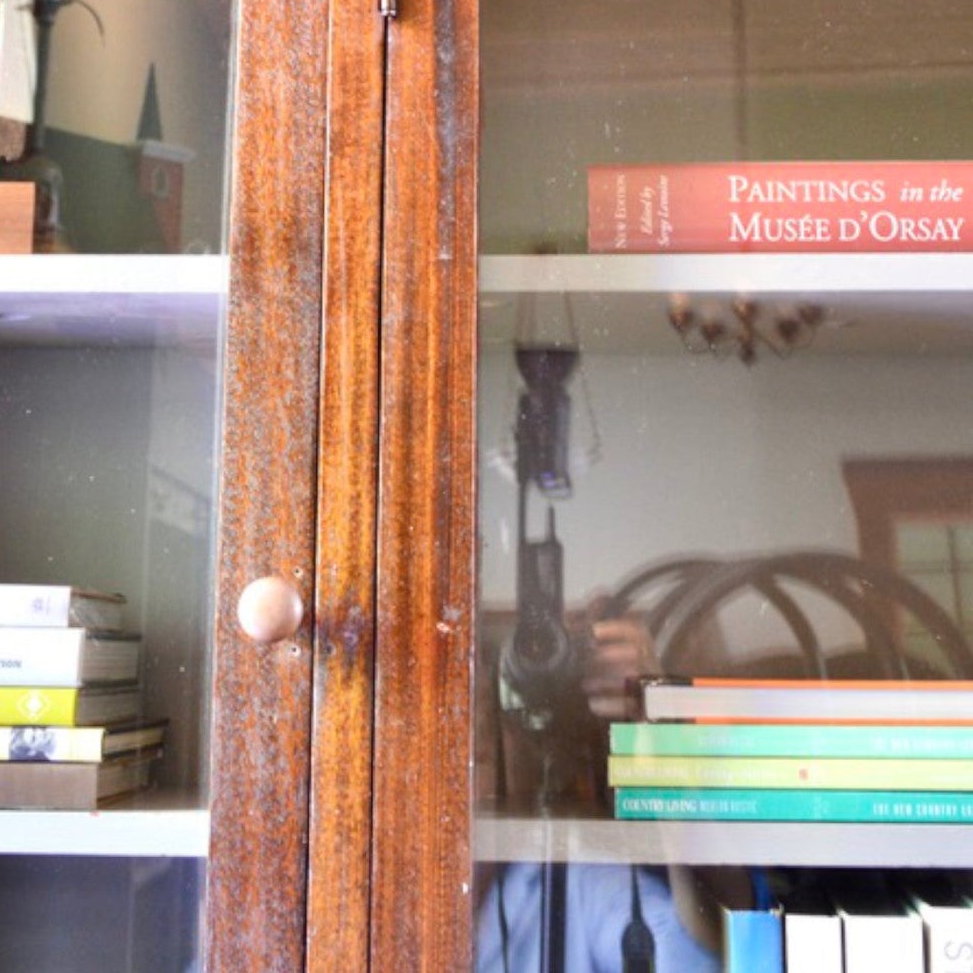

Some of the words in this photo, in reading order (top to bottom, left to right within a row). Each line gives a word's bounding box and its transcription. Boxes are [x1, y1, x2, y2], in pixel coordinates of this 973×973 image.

[729, 175, 886, 203] PAINTINGS
[900, 179, 923, 202] in
[929, 178, 965, 202] the
[729, 213, 832, 243] MUSÉE
